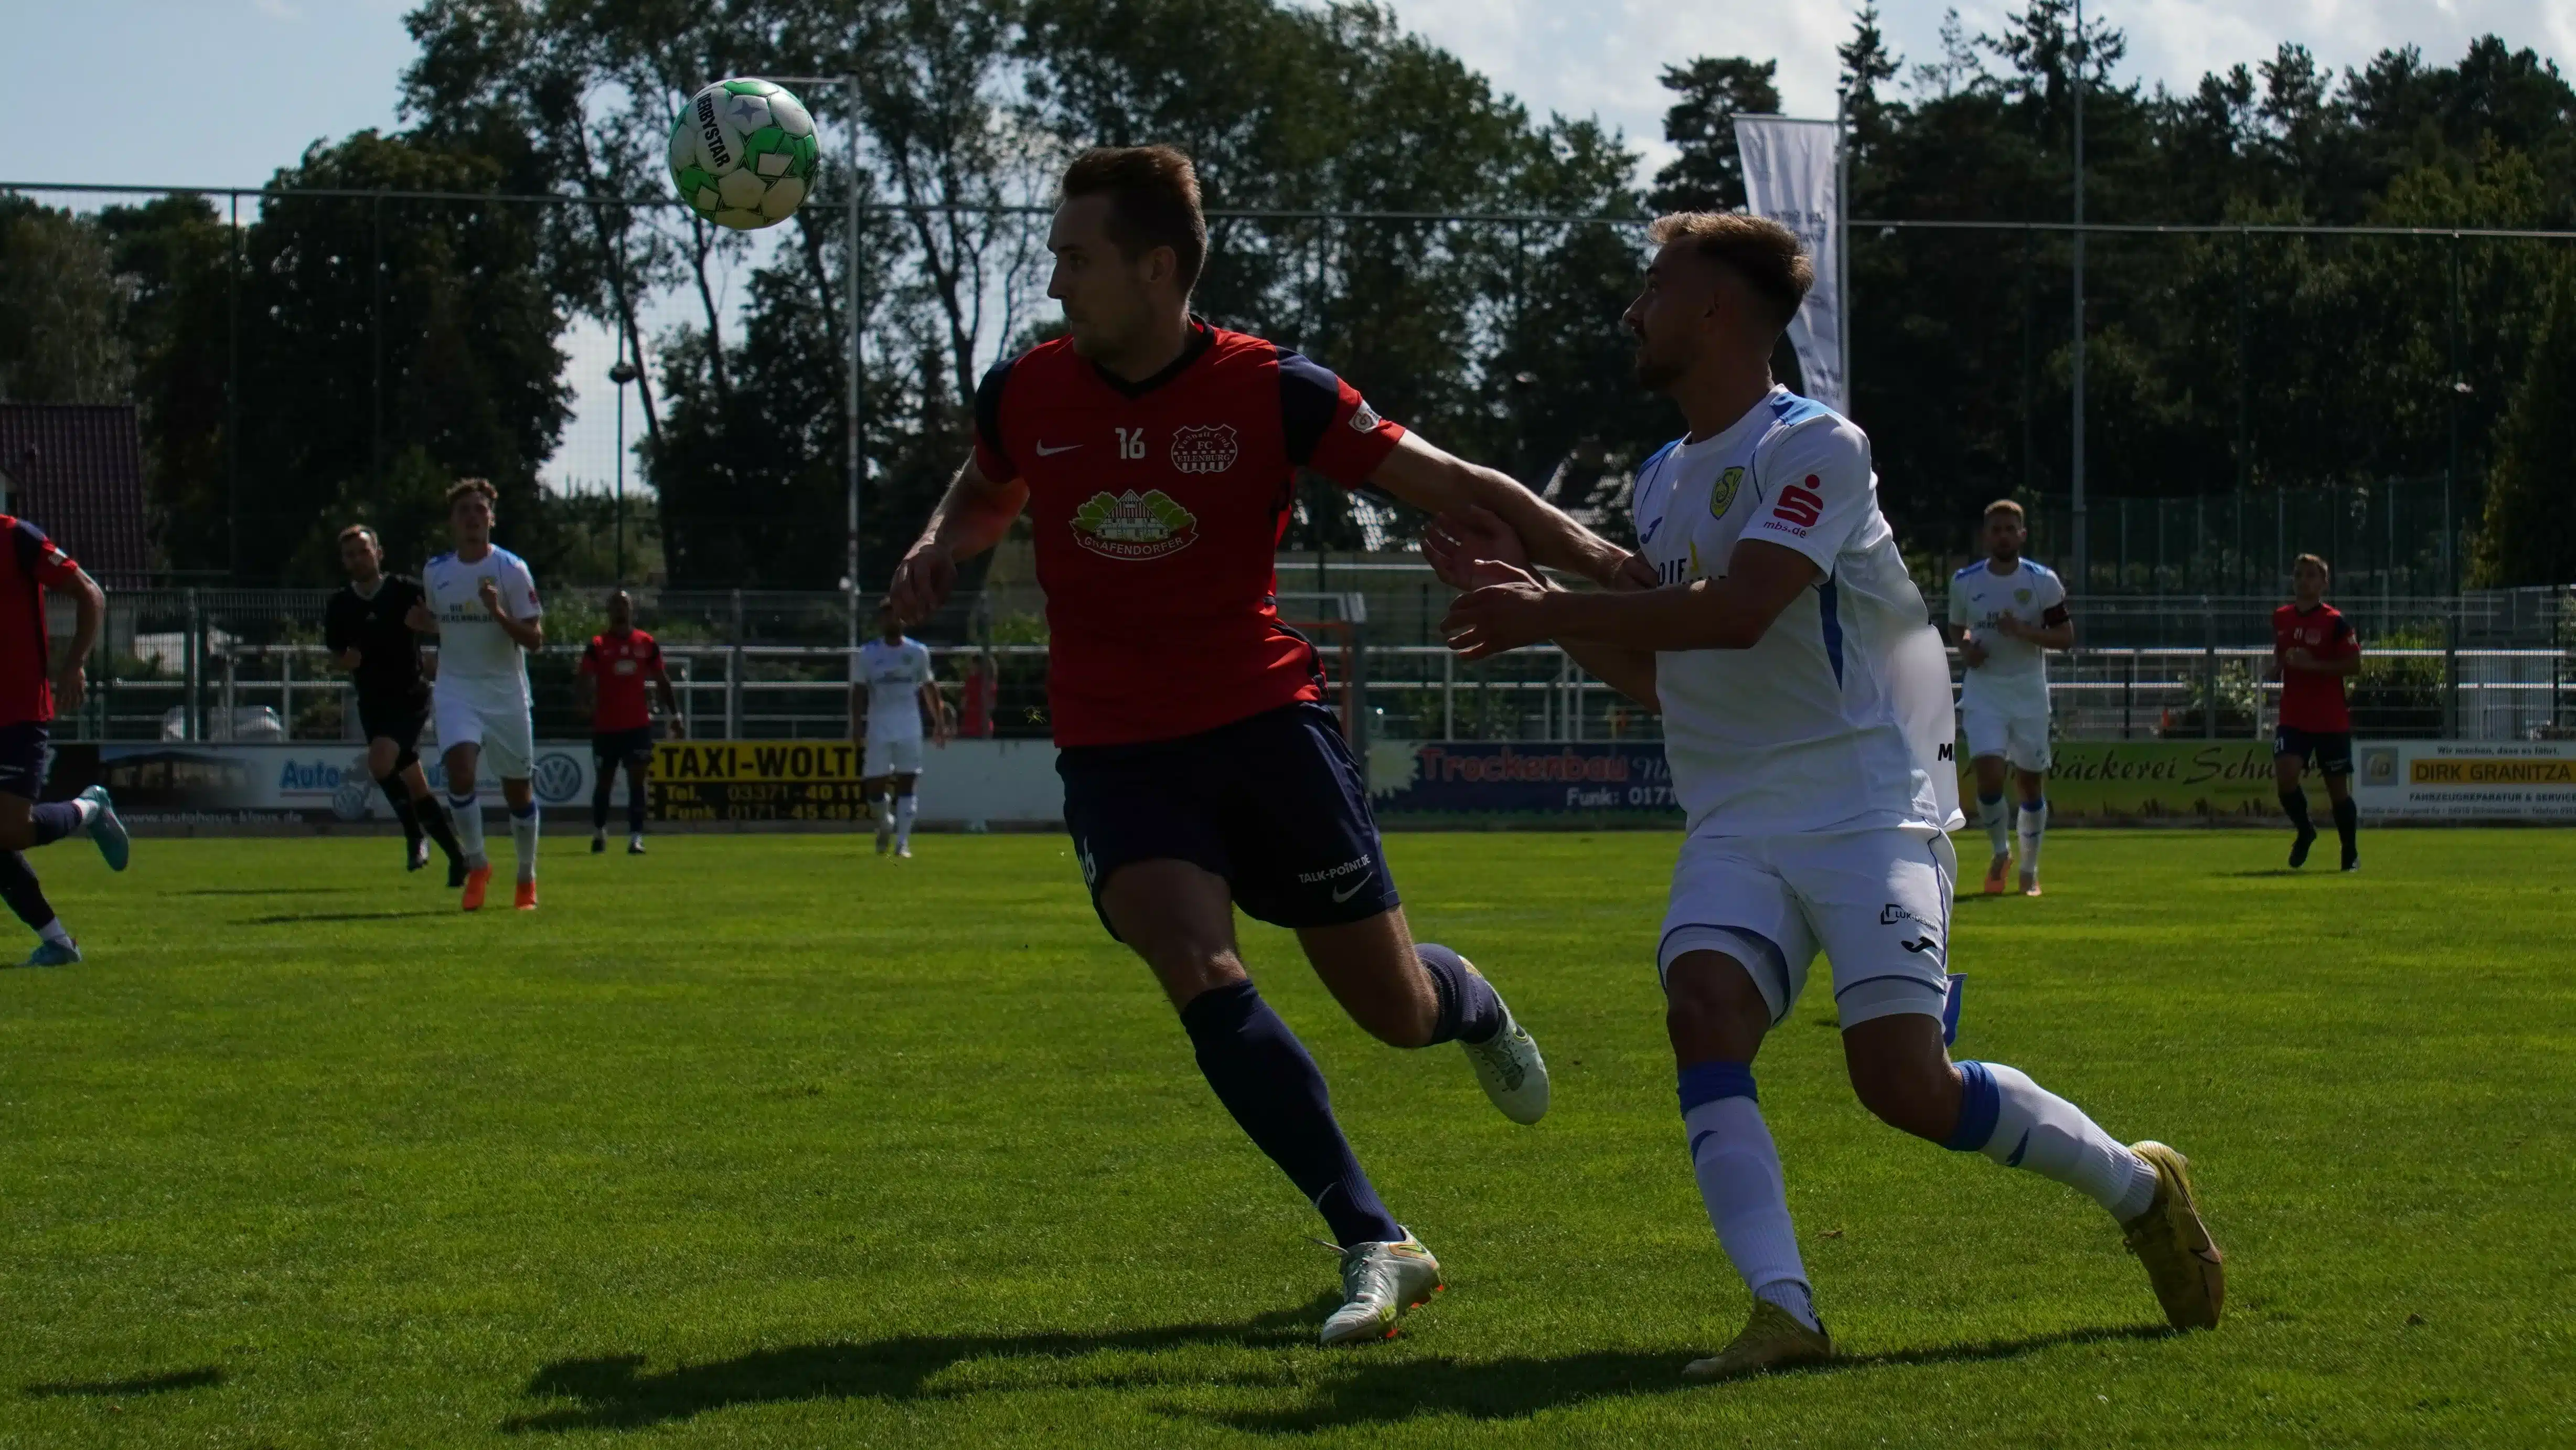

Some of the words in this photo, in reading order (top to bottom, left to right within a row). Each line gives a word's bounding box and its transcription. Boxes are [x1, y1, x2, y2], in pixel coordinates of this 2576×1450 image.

[697, 93, 730, 168] DERBYSTAR
[1115, 428, 1146, 460] 16
[1196, 441, 1213, 450] FC
[1177, 454, 1231, 463] EILENBURG
[1763, 521, 1807, 539] mbs.de
[1419, 745, 1630, 782] Trockenbau
[2415, 763, 2462, 781] DIRK
[2470, 763, 2571, 781] GRANITZA
[1566, 787, 1620, 806] Funk:
